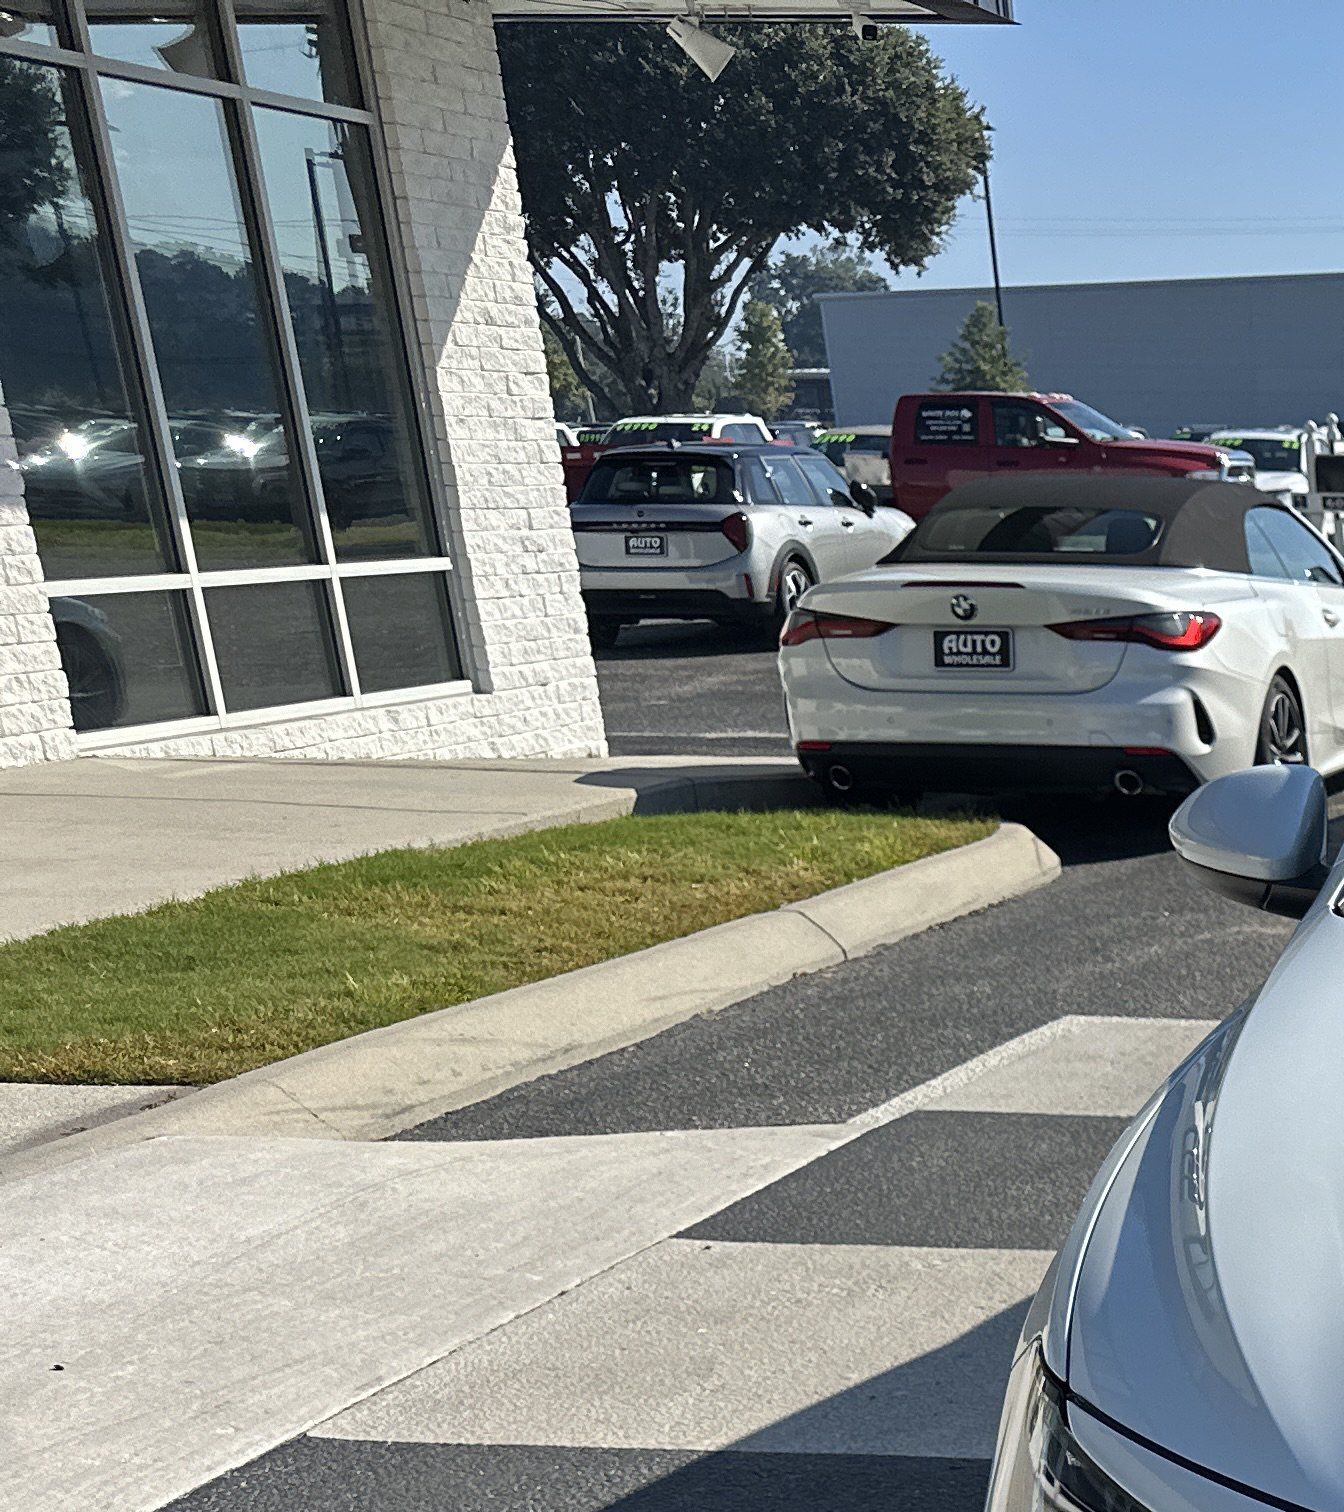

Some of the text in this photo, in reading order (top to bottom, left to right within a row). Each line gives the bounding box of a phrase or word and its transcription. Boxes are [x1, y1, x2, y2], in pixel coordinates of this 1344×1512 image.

[628, 537, 661, 548] AUTO
[942, 633, 1002, 654] AUTO
[943, 655, 1002, 666] WHOLESALE
